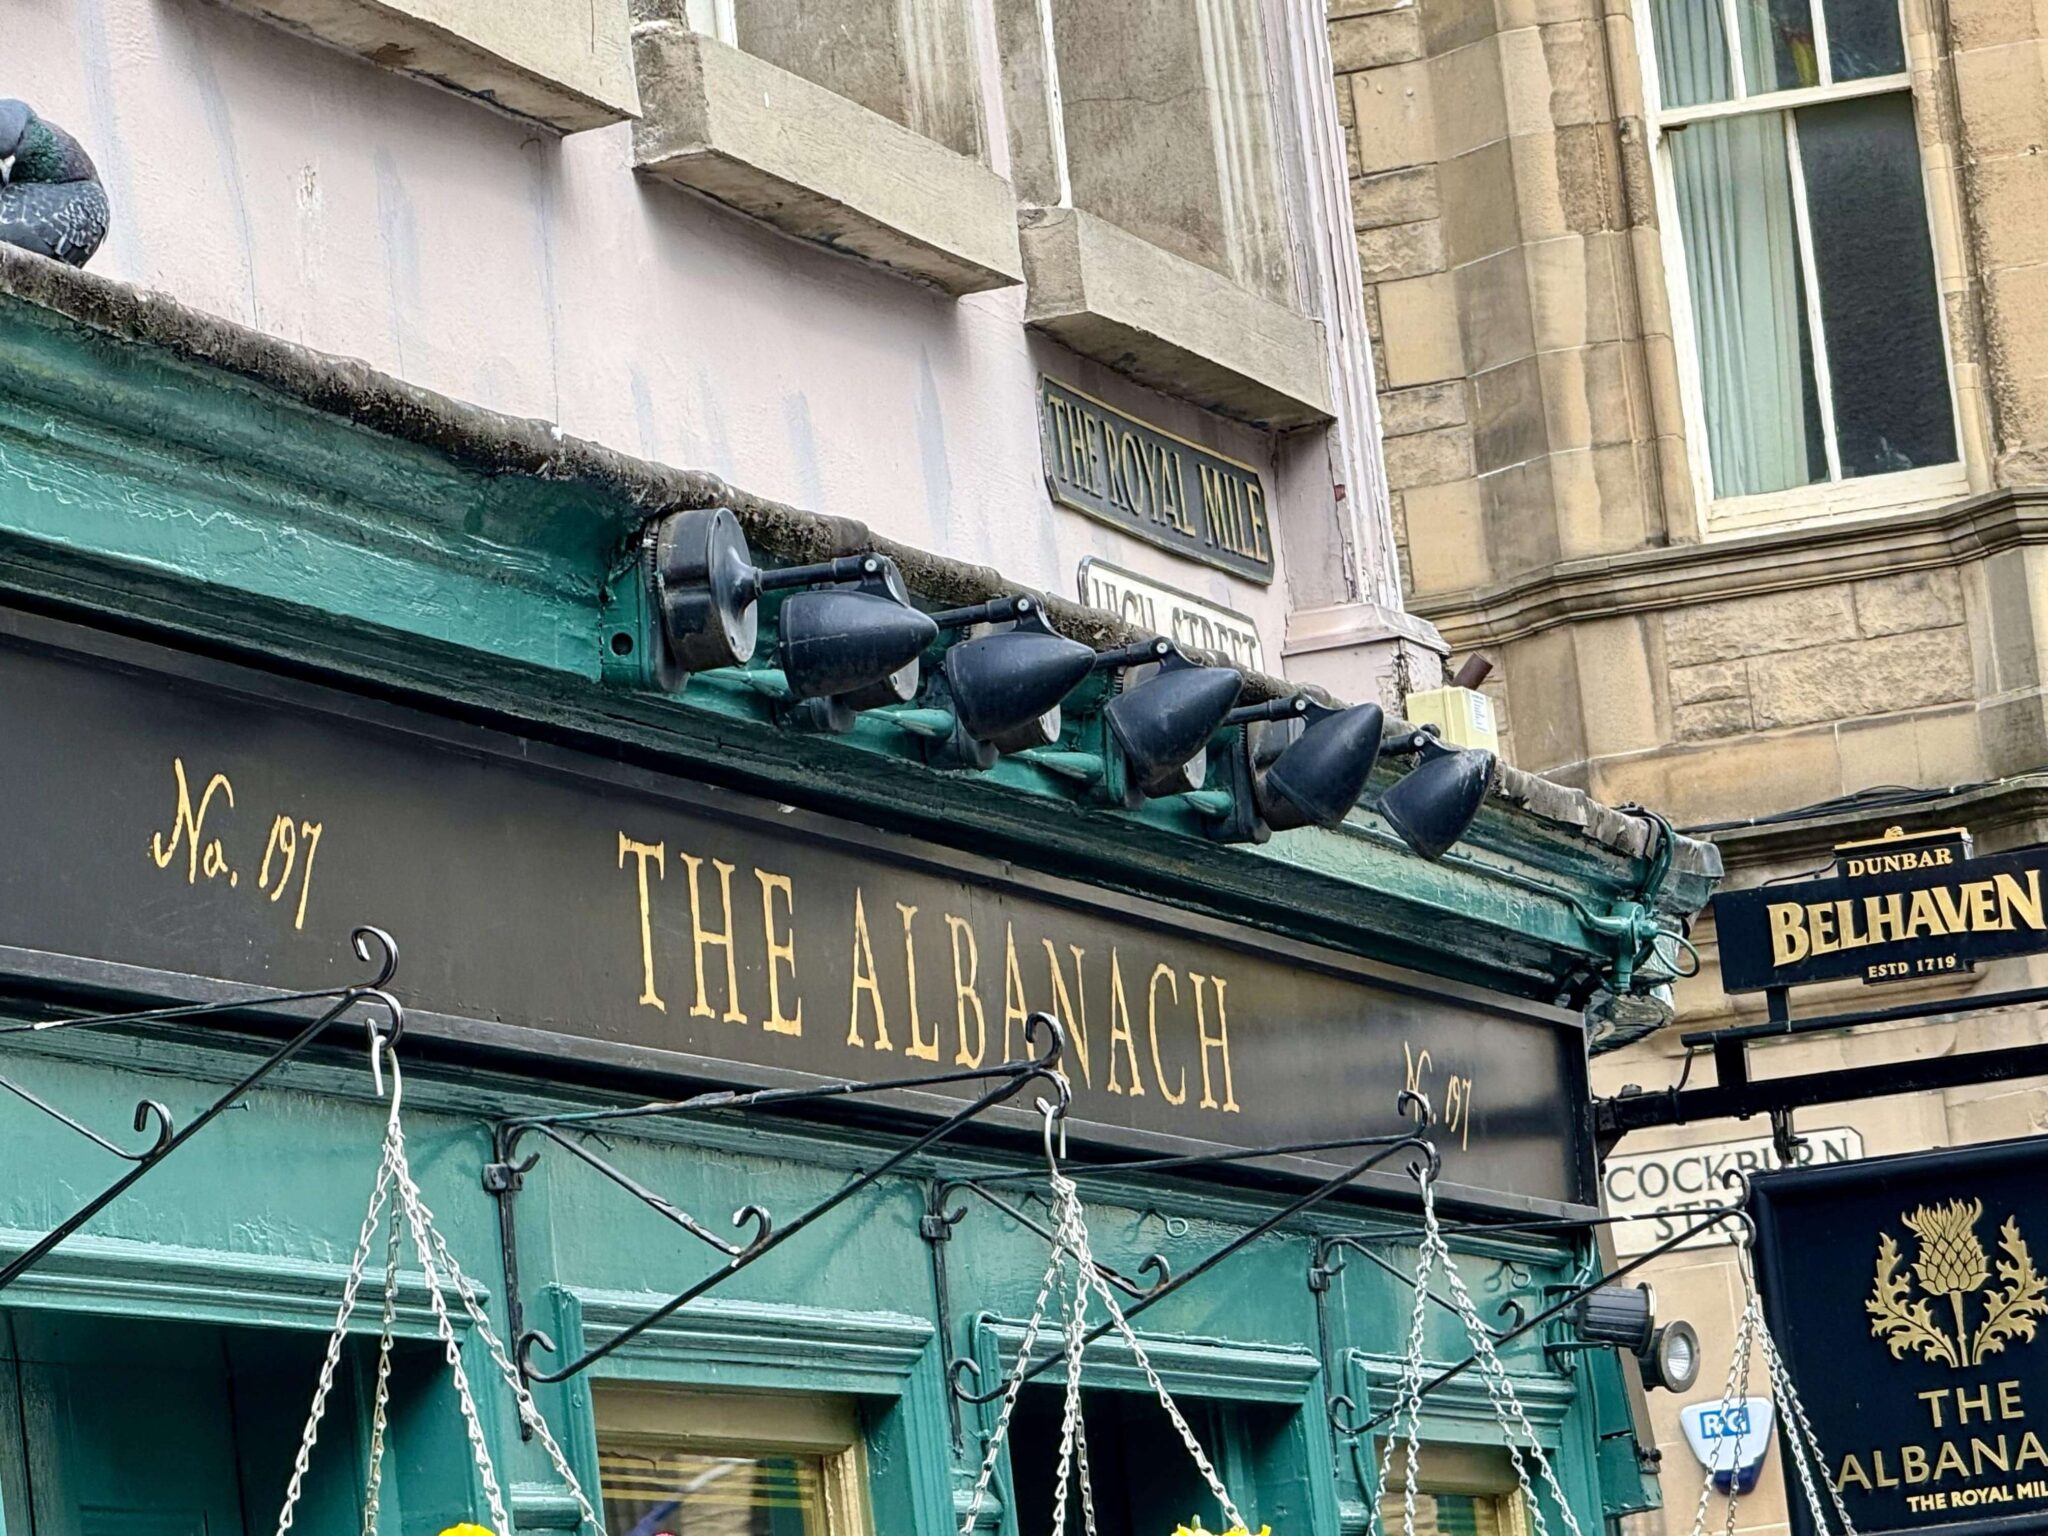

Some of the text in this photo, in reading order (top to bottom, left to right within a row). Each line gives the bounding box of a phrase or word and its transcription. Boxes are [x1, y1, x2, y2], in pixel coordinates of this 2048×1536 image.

[1047, 394, 1269, 564] THE ROYAL MILE
[259, 814, 323, 930] 197
[1847, 848, 1953, 877] DUNBAR
[1766, 869, 2048, 967] BELHAVEN
[618, 831, 1240, 1113] THE ALBANACH
[1868, 955, 1957, 978] ESTD 1719
[1445, 1074, 1472, 1152] 197
[1918, 1380, 2025, 1428] THE
[1836, 1431, 2048, 1493] ALBANA
[1907, 1492, 1947, 1513] THE
[1951, 1485, 2014, 1508] ROYAL
